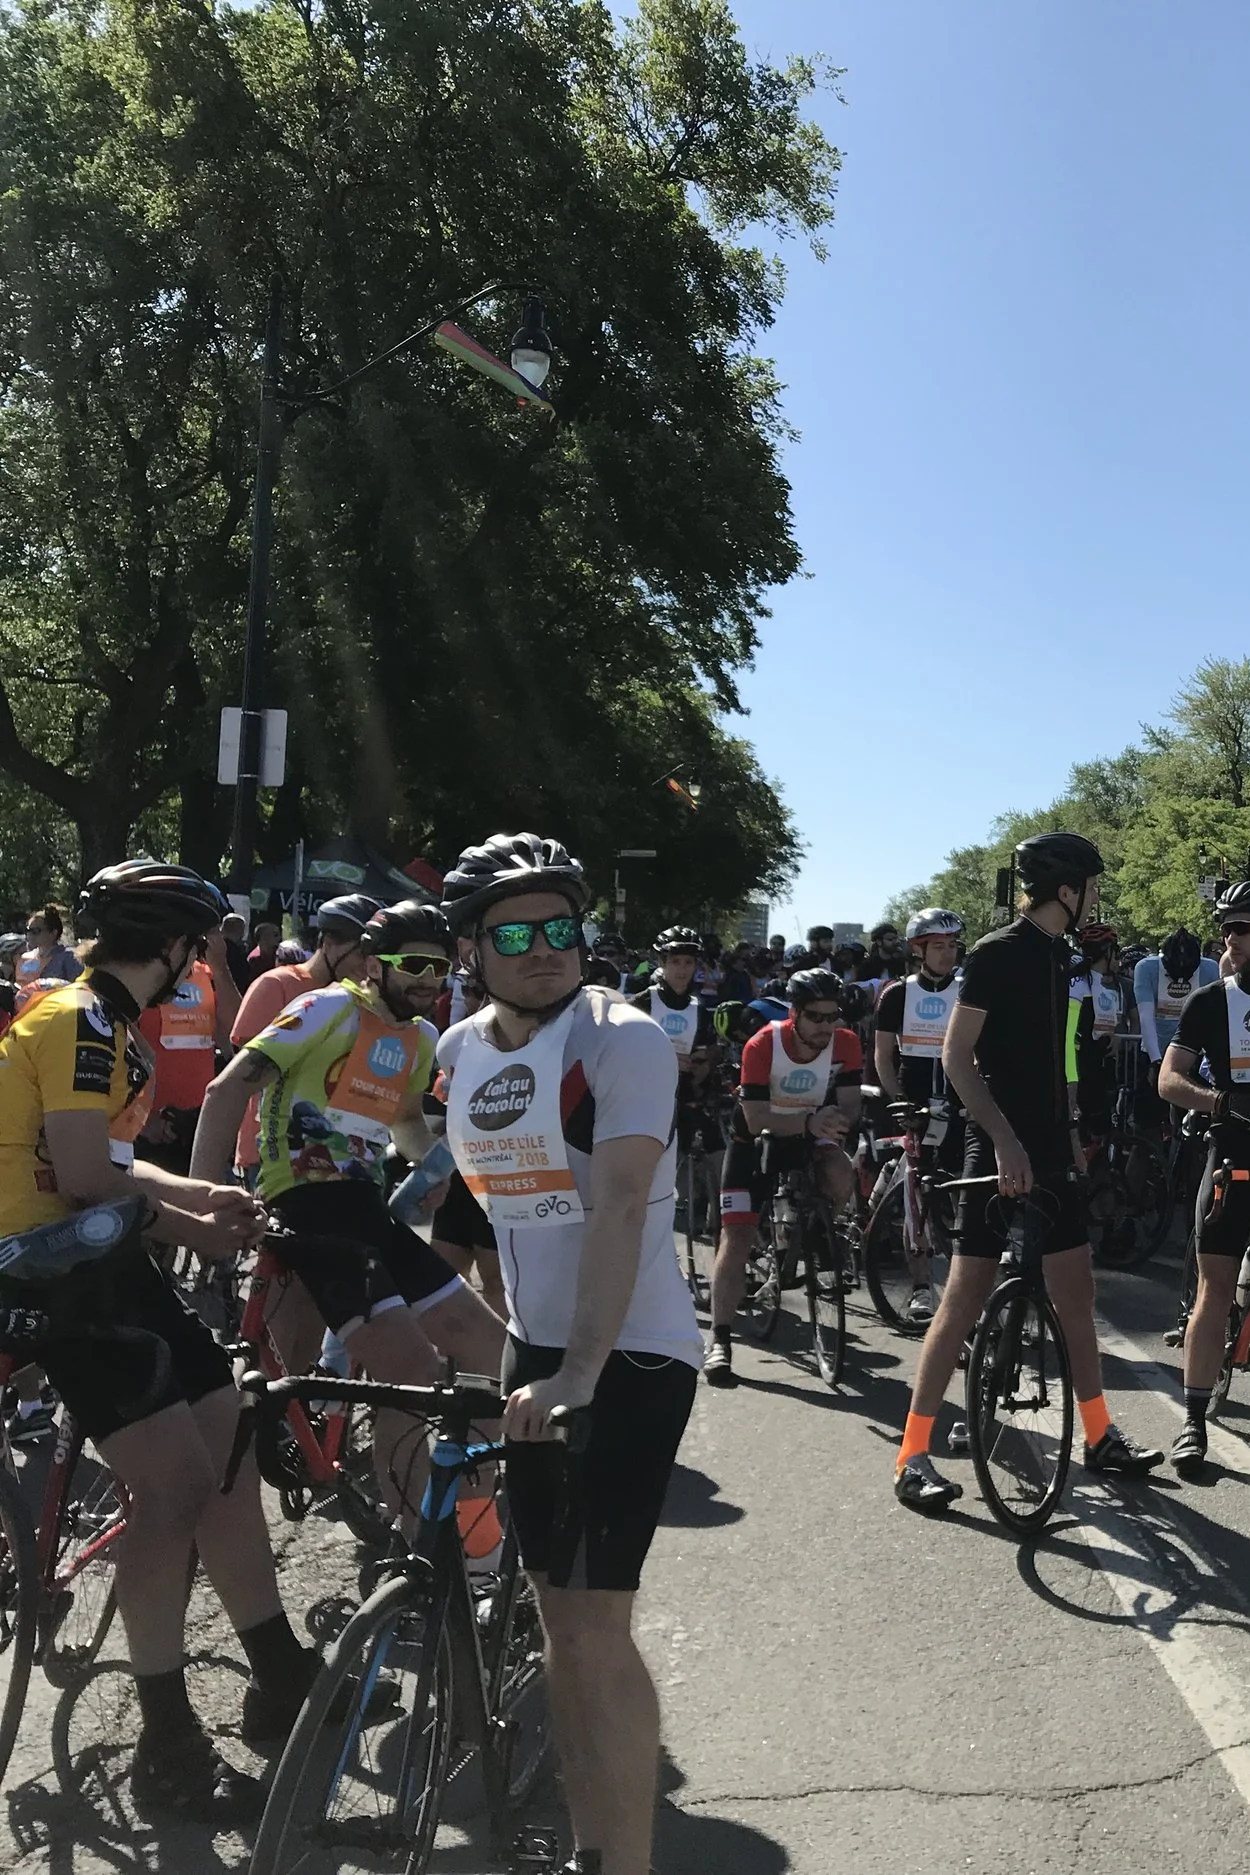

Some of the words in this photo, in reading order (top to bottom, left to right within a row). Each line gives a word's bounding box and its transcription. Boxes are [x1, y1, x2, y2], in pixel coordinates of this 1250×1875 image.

[371, 1038, 406, 1073] lait
[484, 1077, 510, 1097] lait
[510, 1077, 530, 1092] au
[468, 1094, 532, 1115] chocolat
[462, 1139, 495, 1154] TOUR
[497, 1138, 516, 1151] DE
[516, 1152, 550, 1168] 2018
[535, 1195, 571, 1218] GVO
